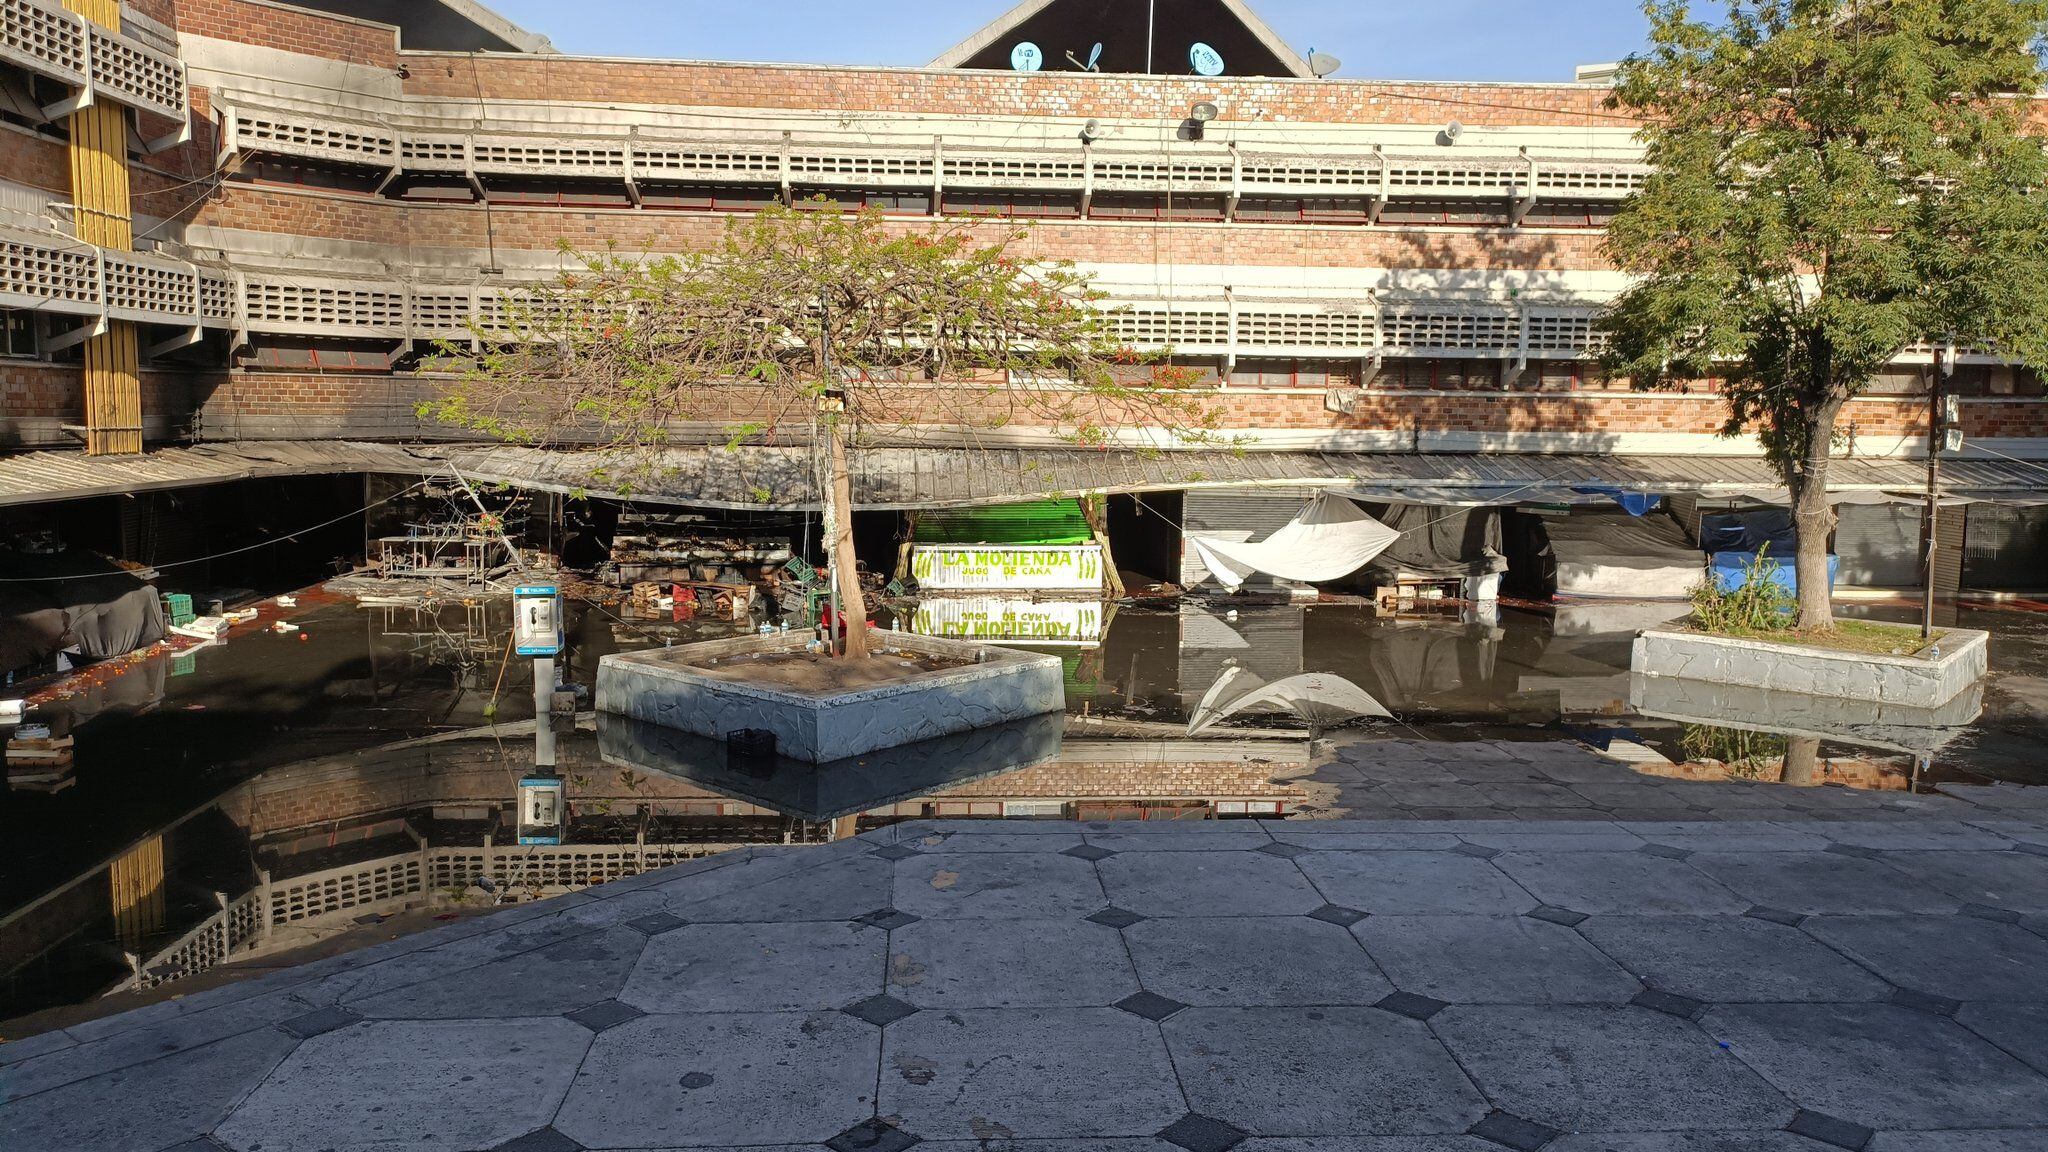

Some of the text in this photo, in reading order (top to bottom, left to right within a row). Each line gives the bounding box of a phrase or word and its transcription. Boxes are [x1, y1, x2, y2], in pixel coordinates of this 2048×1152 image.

[943, 551, 1072, 566] LA MOLIENDA
[962, 567, 989, 575] JUGO
[1003, 567, 1017, 575] DE
